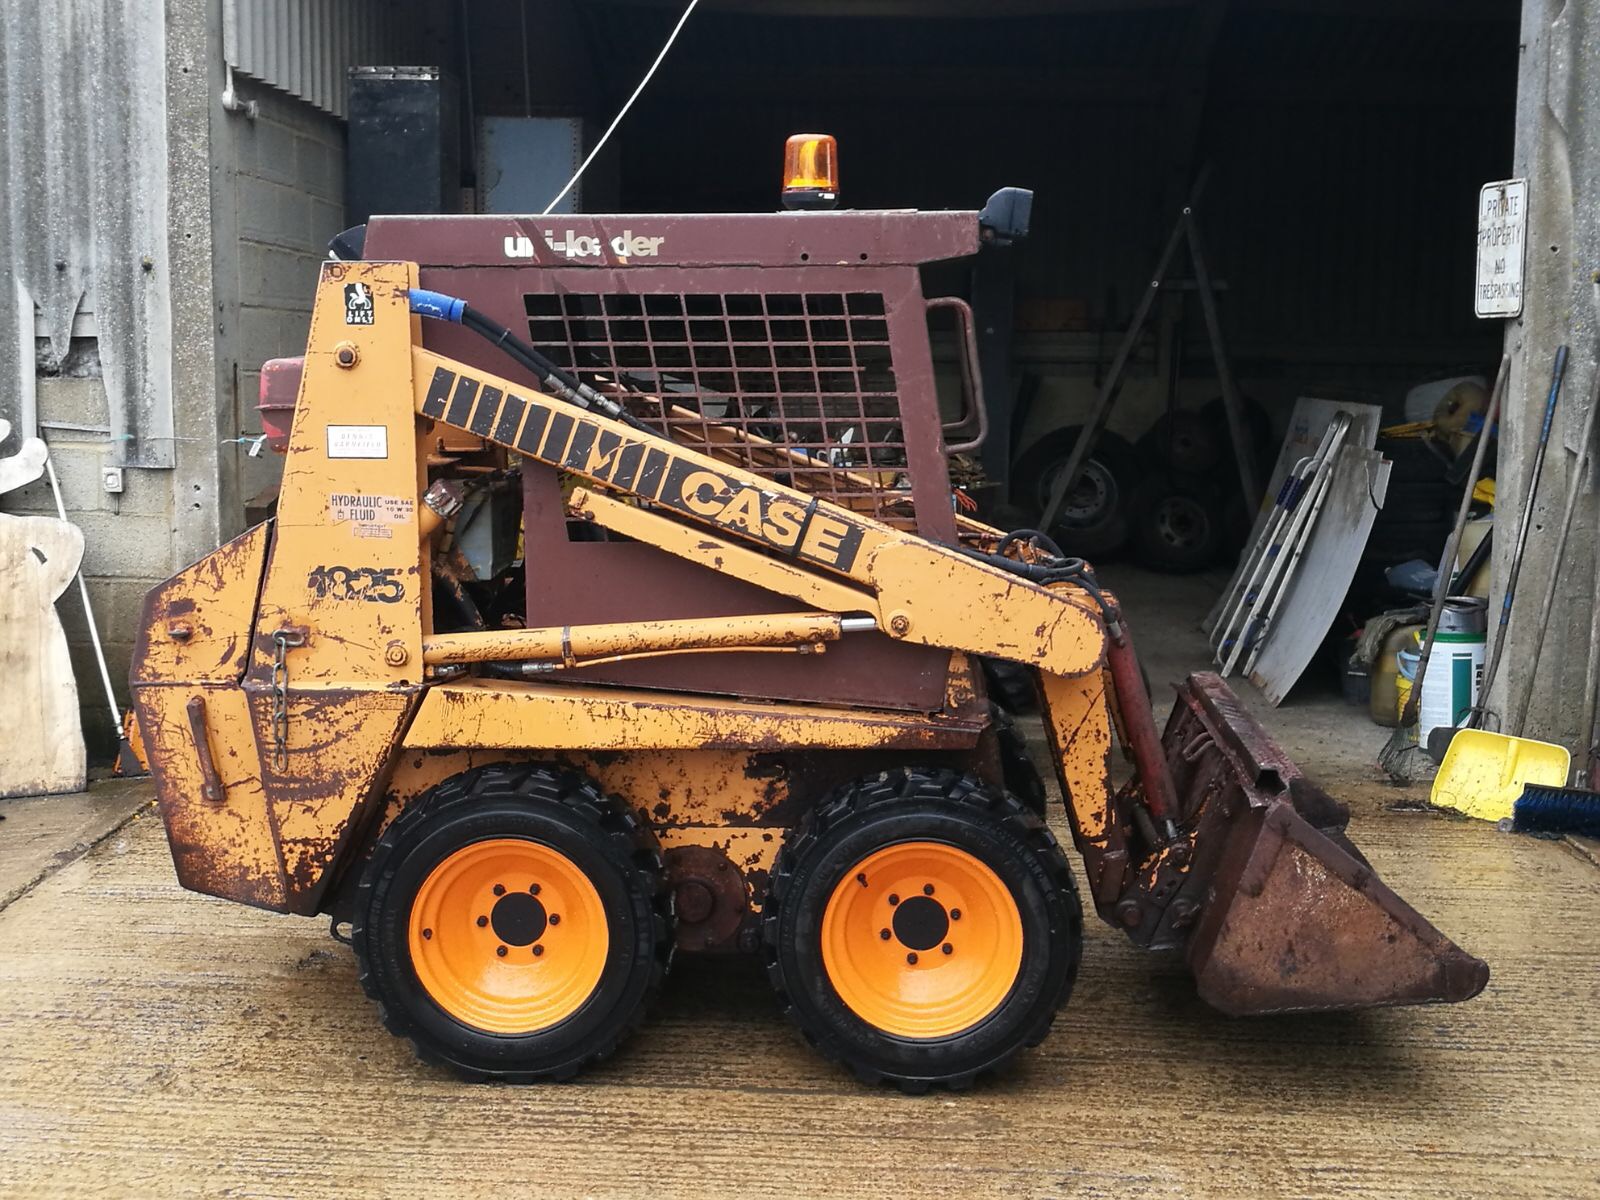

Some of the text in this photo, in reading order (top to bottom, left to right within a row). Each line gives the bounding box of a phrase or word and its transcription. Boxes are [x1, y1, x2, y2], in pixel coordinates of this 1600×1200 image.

[1487, 196, 1518, 218] PRIVATE
[1480, 225, 1521, 247] PROPERTY
[1495, 258, 1505, 274] NO
[1480, 282, 1520, 299] TRESPASSING
[331, 495, 382, 508] HYDRAULIC
[350, 510, 375, 520] FLUID
[681, 471, 849, 564] CASE
[309, 565, 406, 603] 1825
